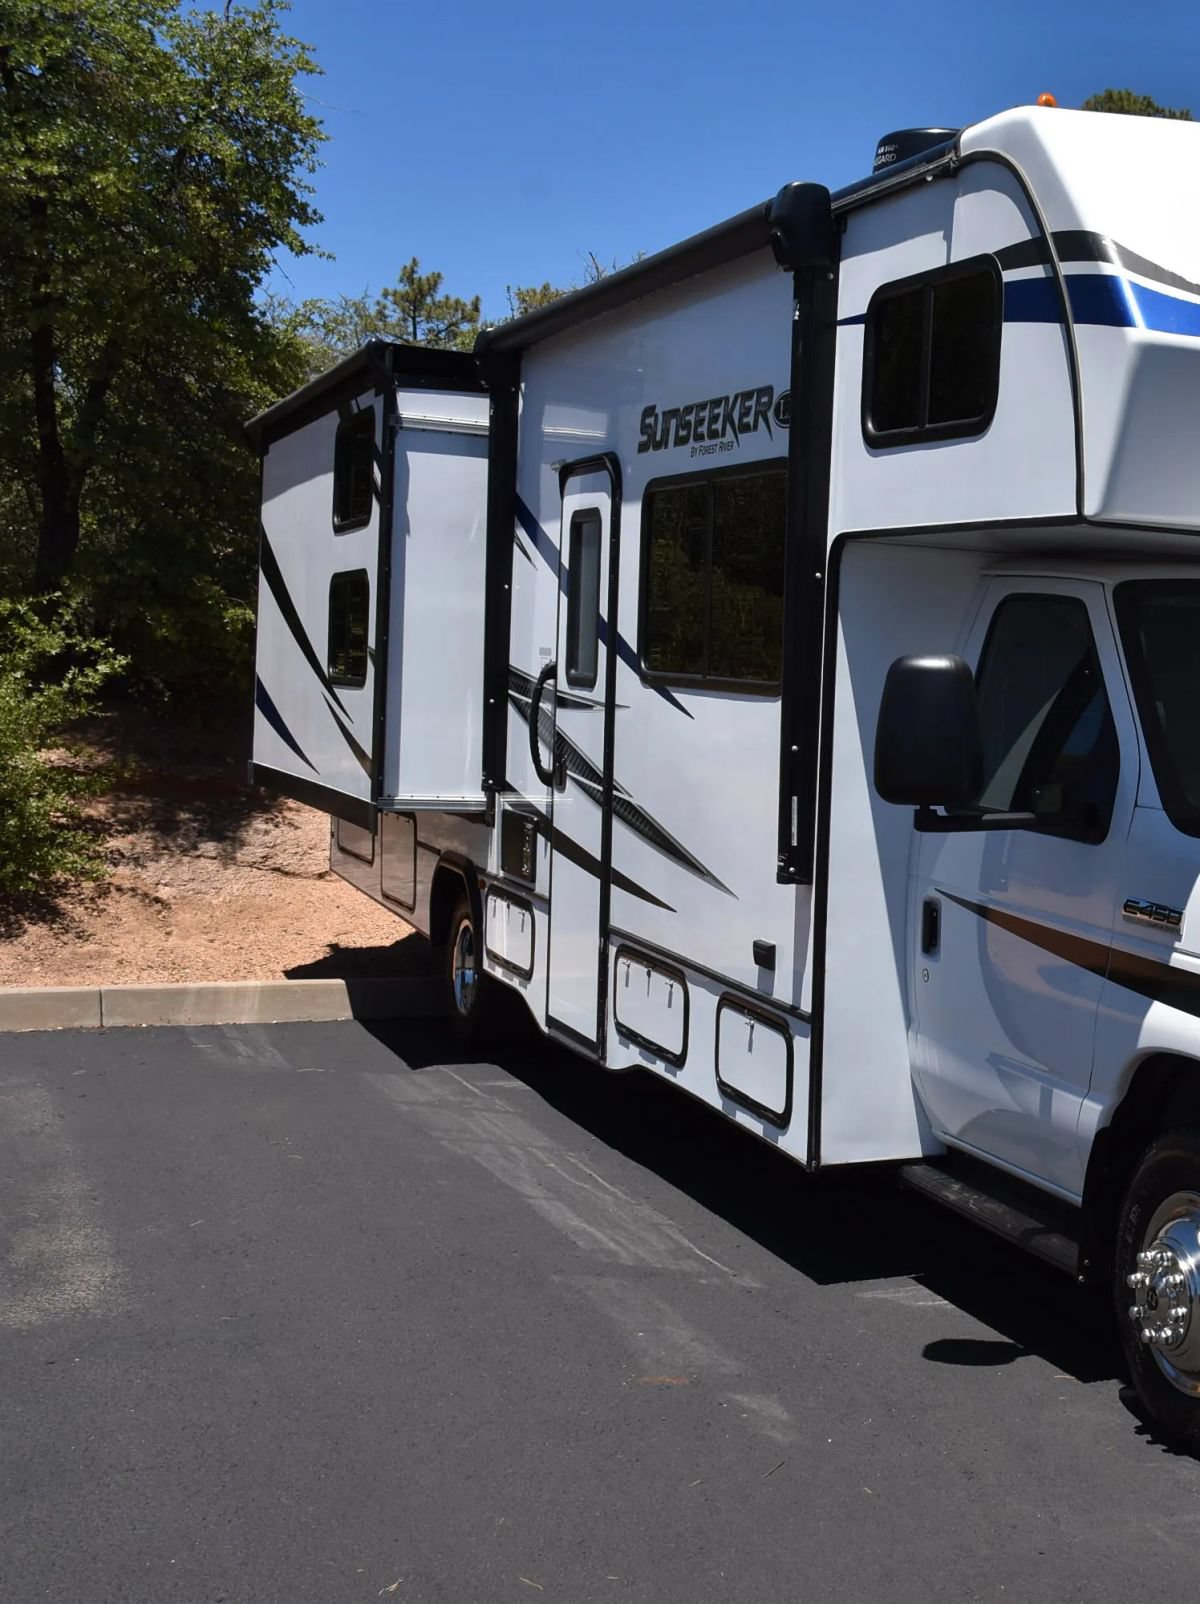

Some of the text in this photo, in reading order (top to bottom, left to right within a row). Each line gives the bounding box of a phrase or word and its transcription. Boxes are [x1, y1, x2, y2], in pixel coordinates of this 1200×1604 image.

[690, 440, 734, 458] BY FOREST RIVER
